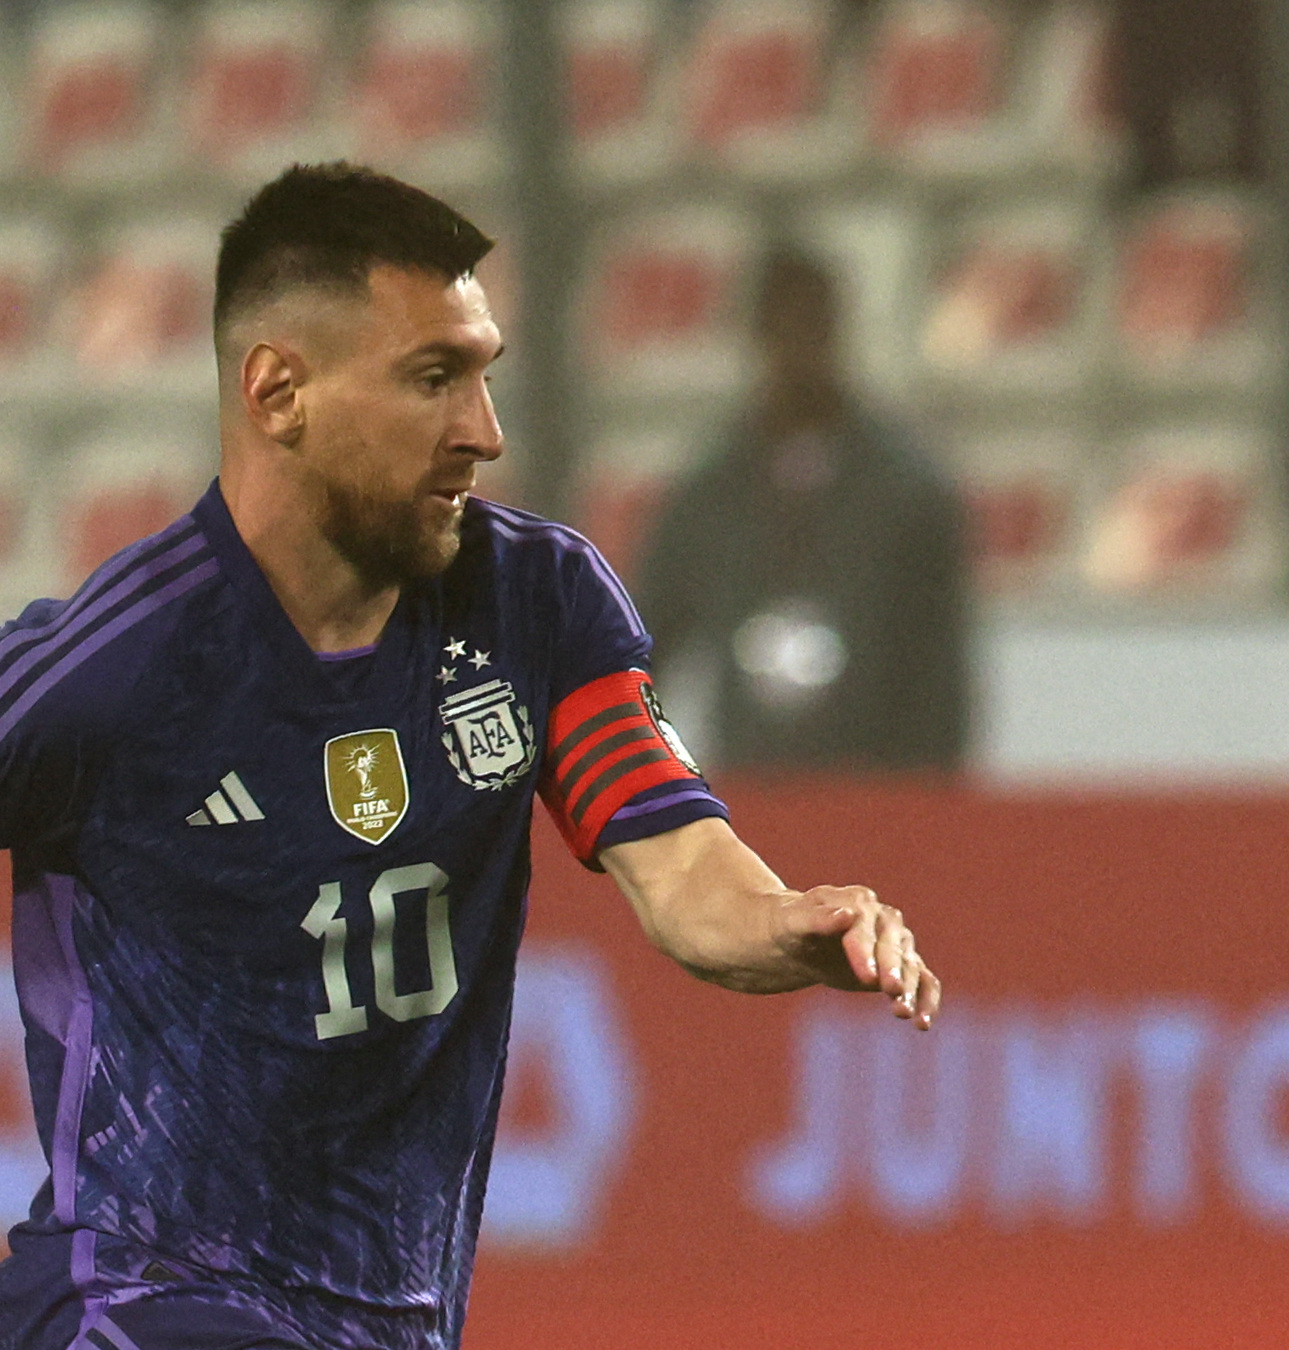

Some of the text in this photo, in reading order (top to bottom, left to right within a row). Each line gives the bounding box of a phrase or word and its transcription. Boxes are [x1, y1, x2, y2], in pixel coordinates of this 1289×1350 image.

[467, 711, 515, 759] AFA
[353, 799, 389, 817] FIFA
[300, 862, 459, 1041] 10
